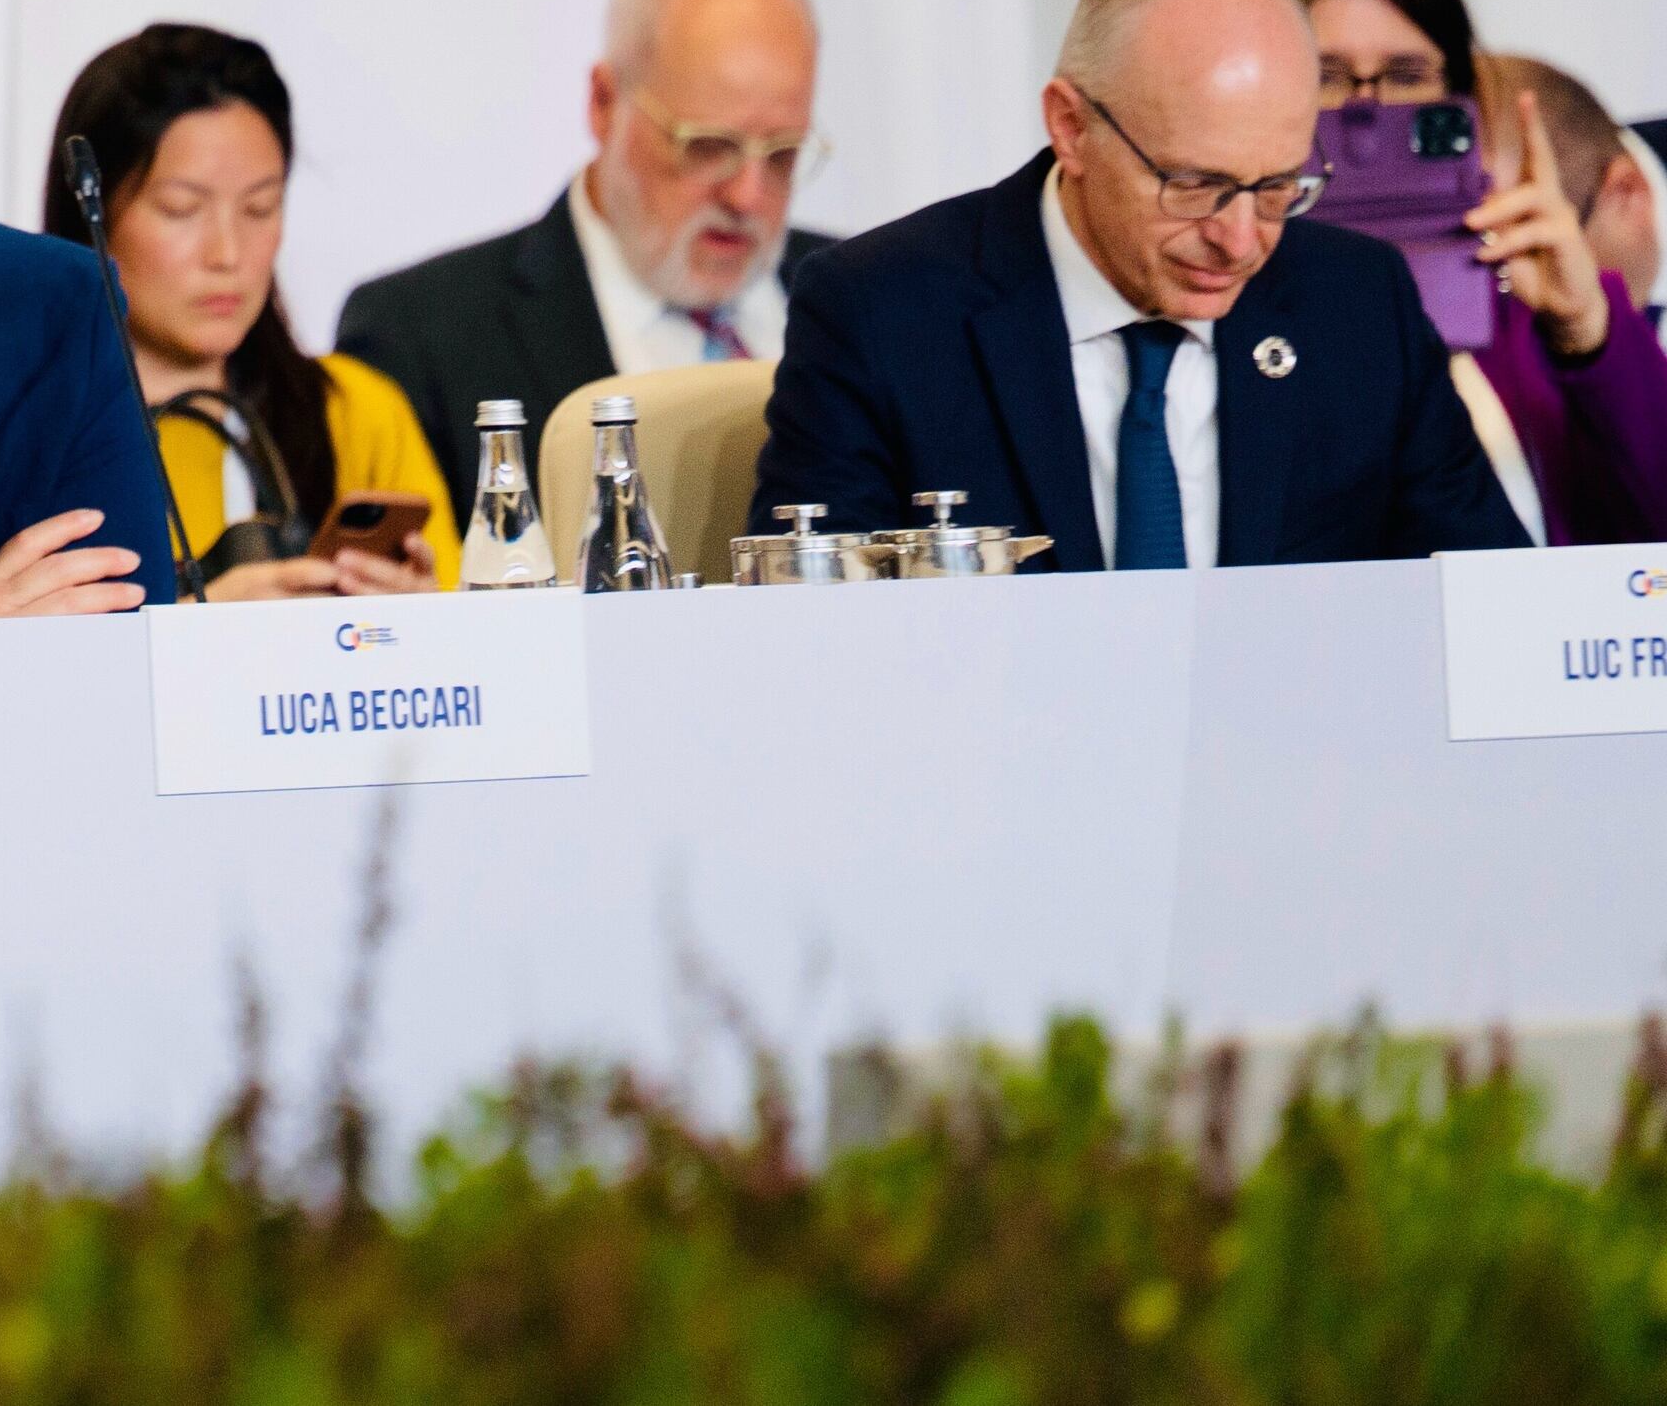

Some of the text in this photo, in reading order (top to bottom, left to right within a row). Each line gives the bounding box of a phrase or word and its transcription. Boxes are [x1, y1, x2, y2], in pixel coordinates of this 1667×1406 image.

[1564, 636, 1667, 681] LUC FR
[260, 685, 481, 736] LUCA BECCARI
